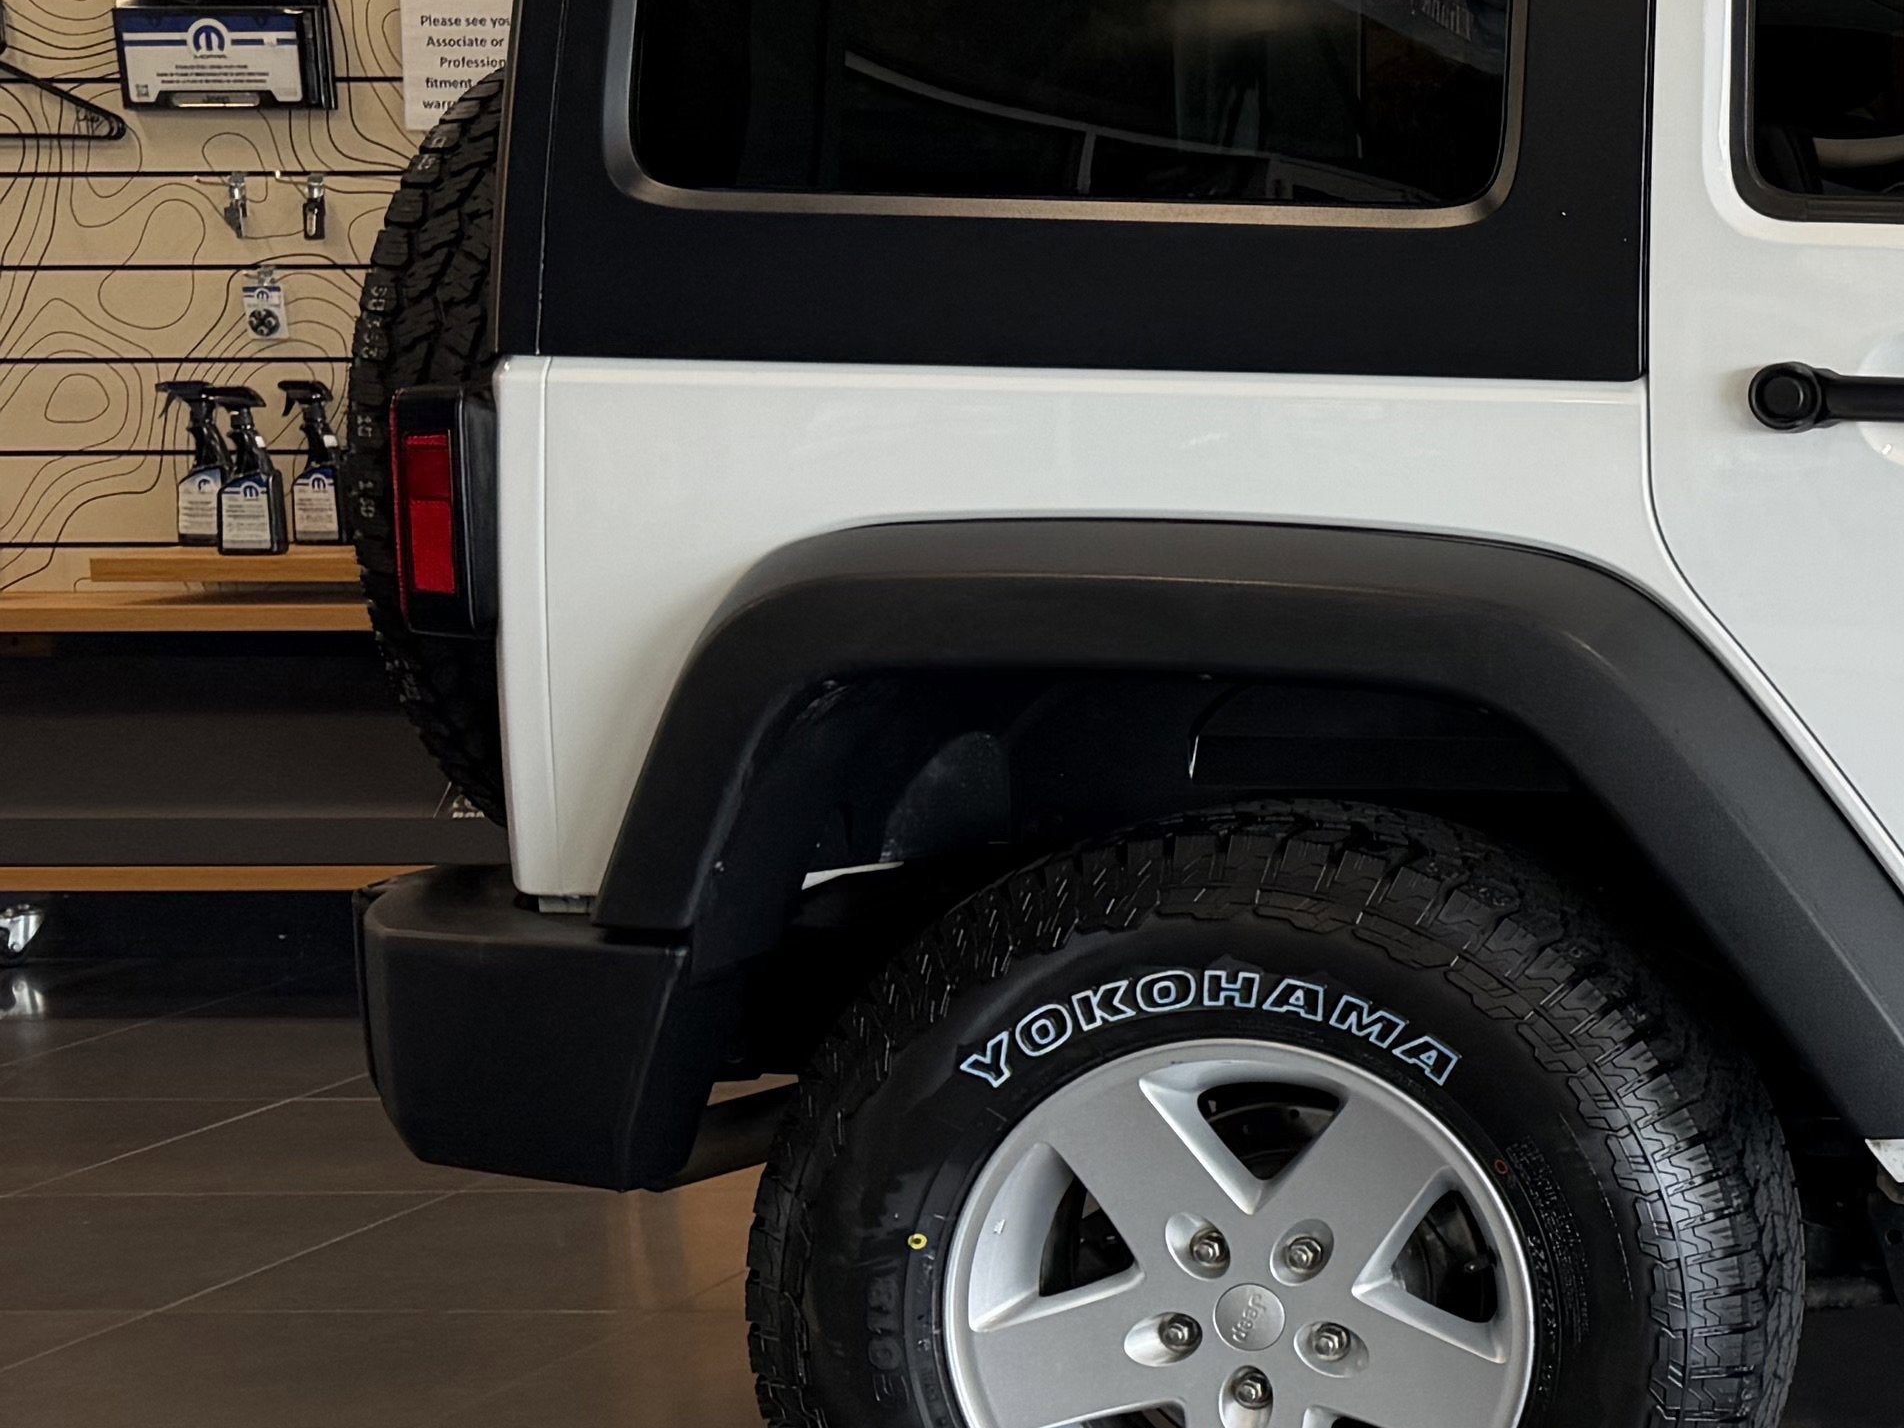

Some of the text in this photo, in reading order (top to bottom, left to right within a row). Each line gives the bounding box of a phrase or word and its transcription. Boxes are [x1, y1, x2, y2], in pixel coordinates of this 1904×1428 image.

[420, 15, 462, 27] Please
[465, 17, 487, 27] see
[426, 35, 505, 48] Associate or
[425, 77, 472, 89] fitment
[957, 968, 1463, 1092] YOKOHAMA
[1230, 1292, 1267, 1343] Jeep
